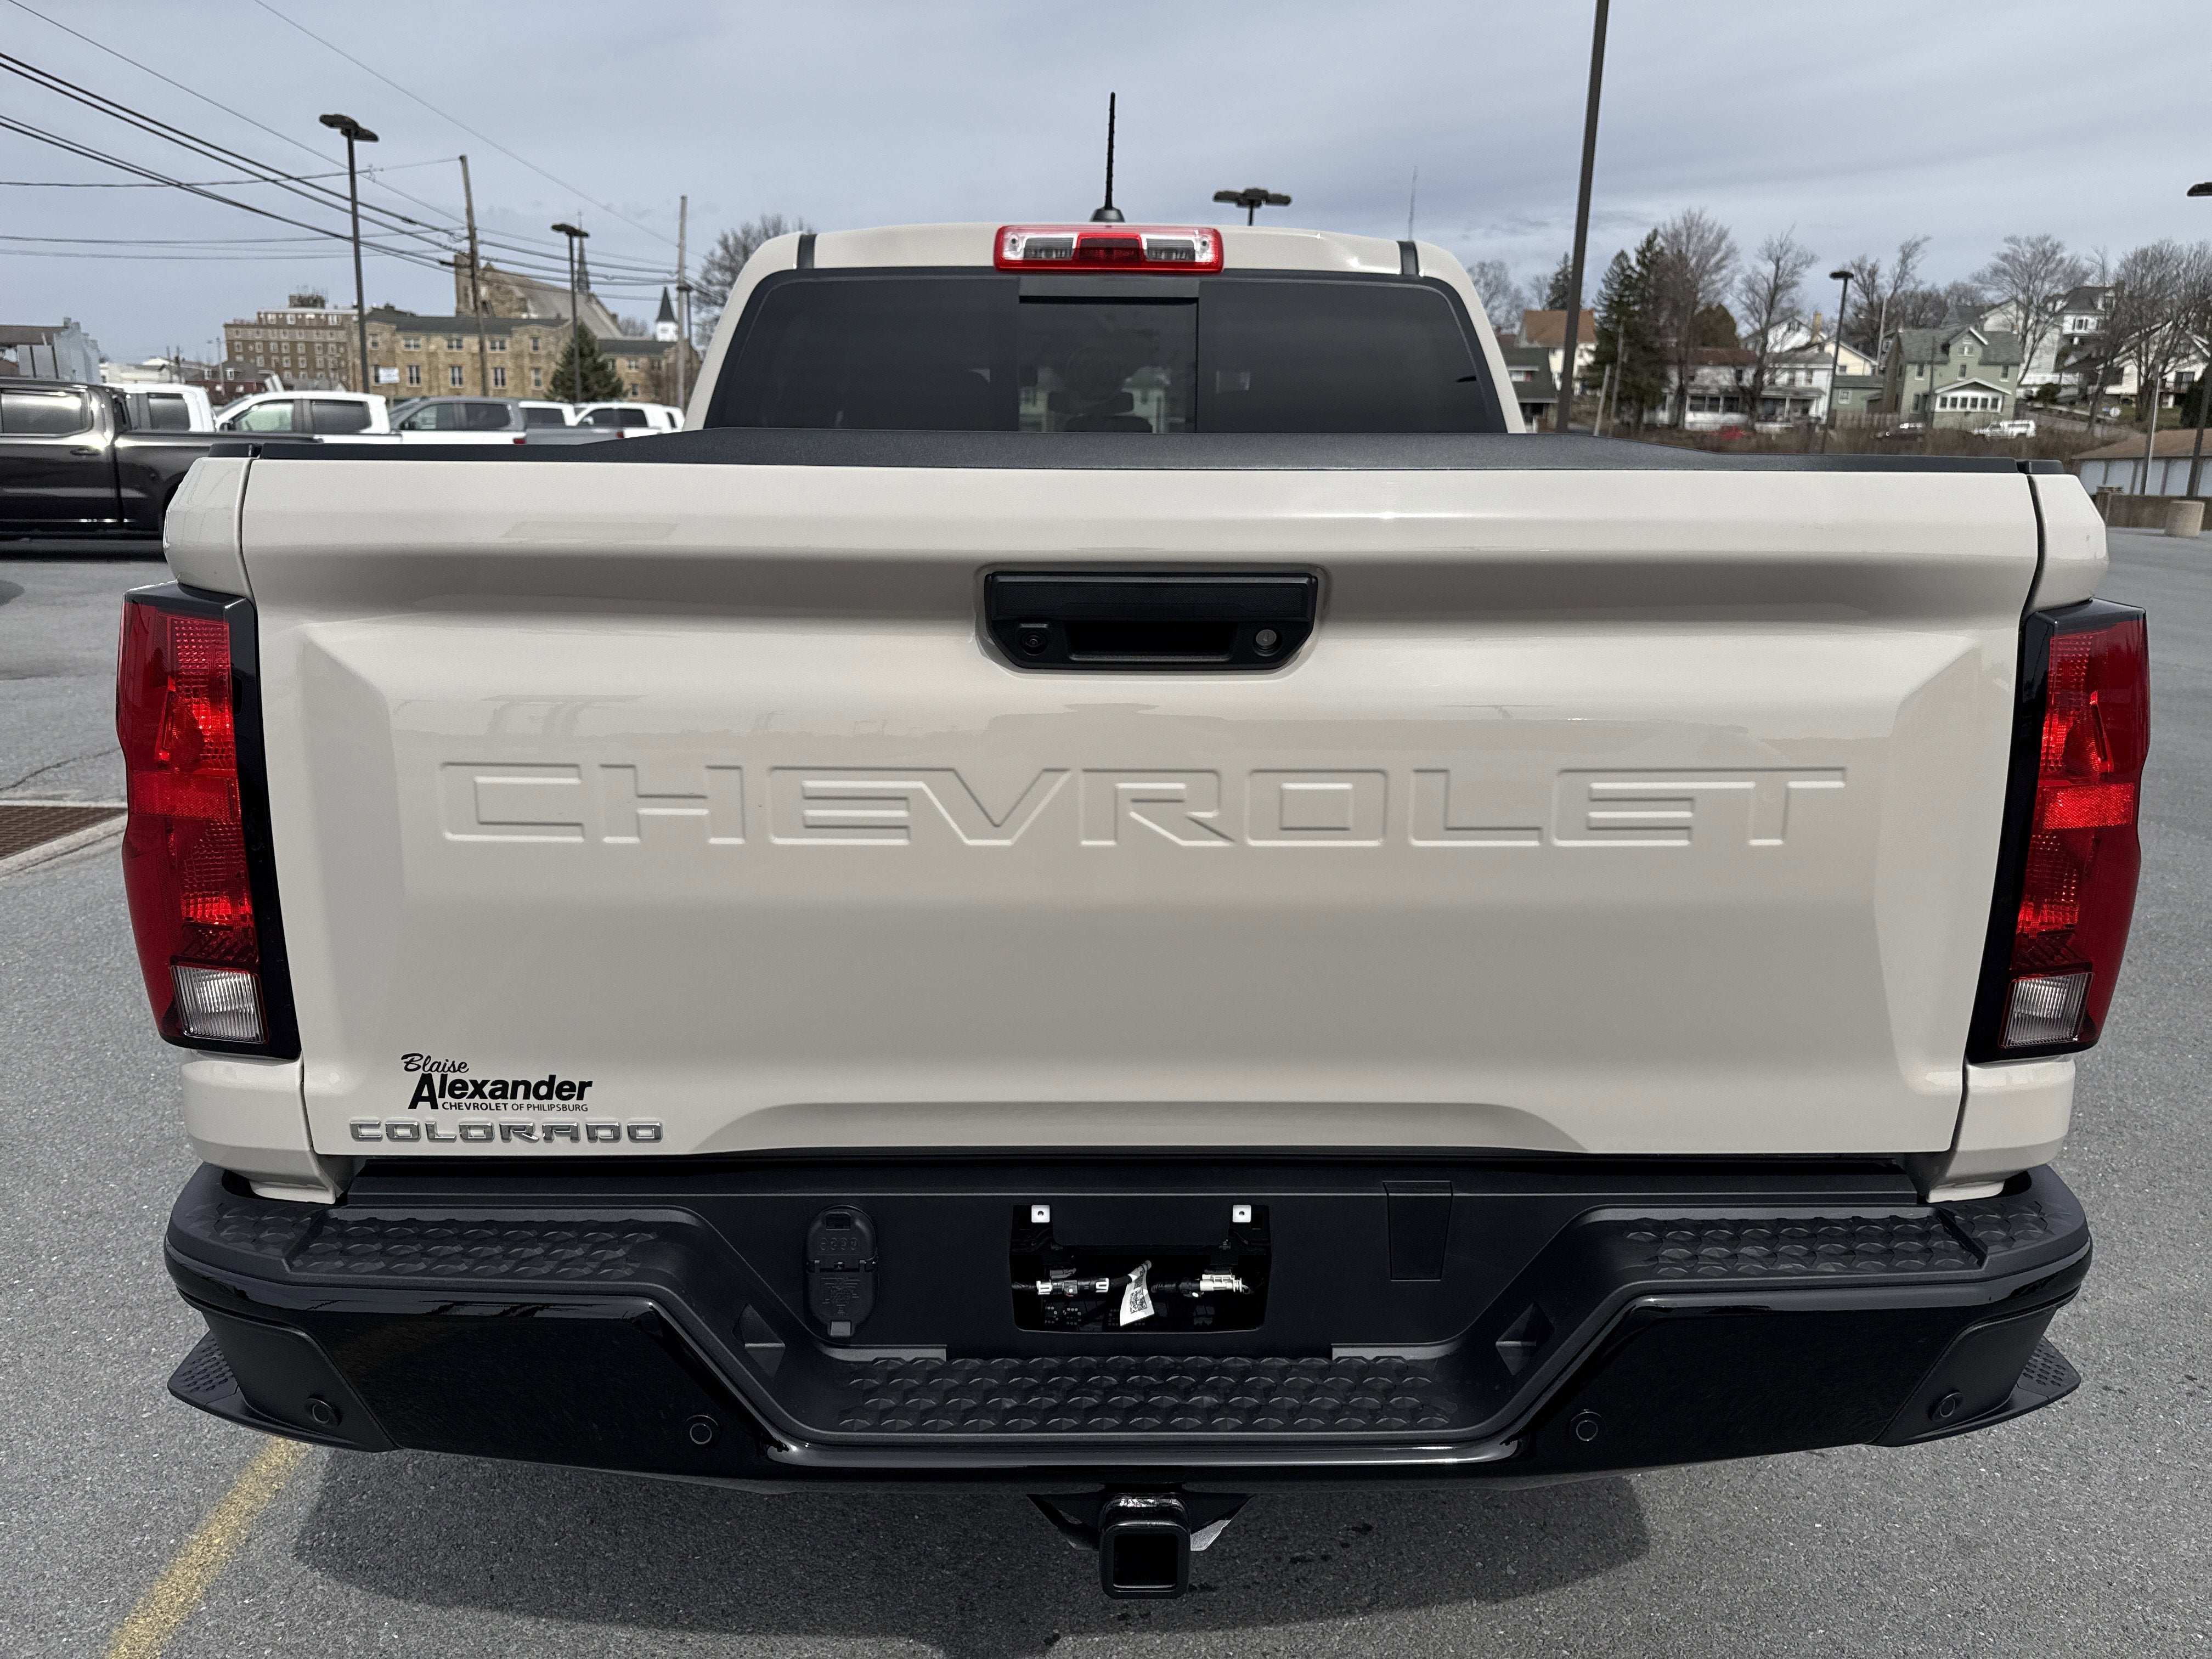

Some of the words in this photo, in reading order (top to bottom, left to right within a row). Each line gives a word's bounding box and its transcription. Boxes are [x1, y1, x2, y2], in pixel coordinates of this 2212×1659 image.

[440, 761, 1847, 849] CHEVROLET
[400, 1053, 470, 1073] Blaise
[408, 1073, 594, 1110] Alexander
[441, 1101, 509, 1111] CHEVROLET
[511, 1103, 525, 1111] OF
[526, 1103, 589, 1112] PHILIPSBURG
[349, 1120, 664, 1143] COLORADO
